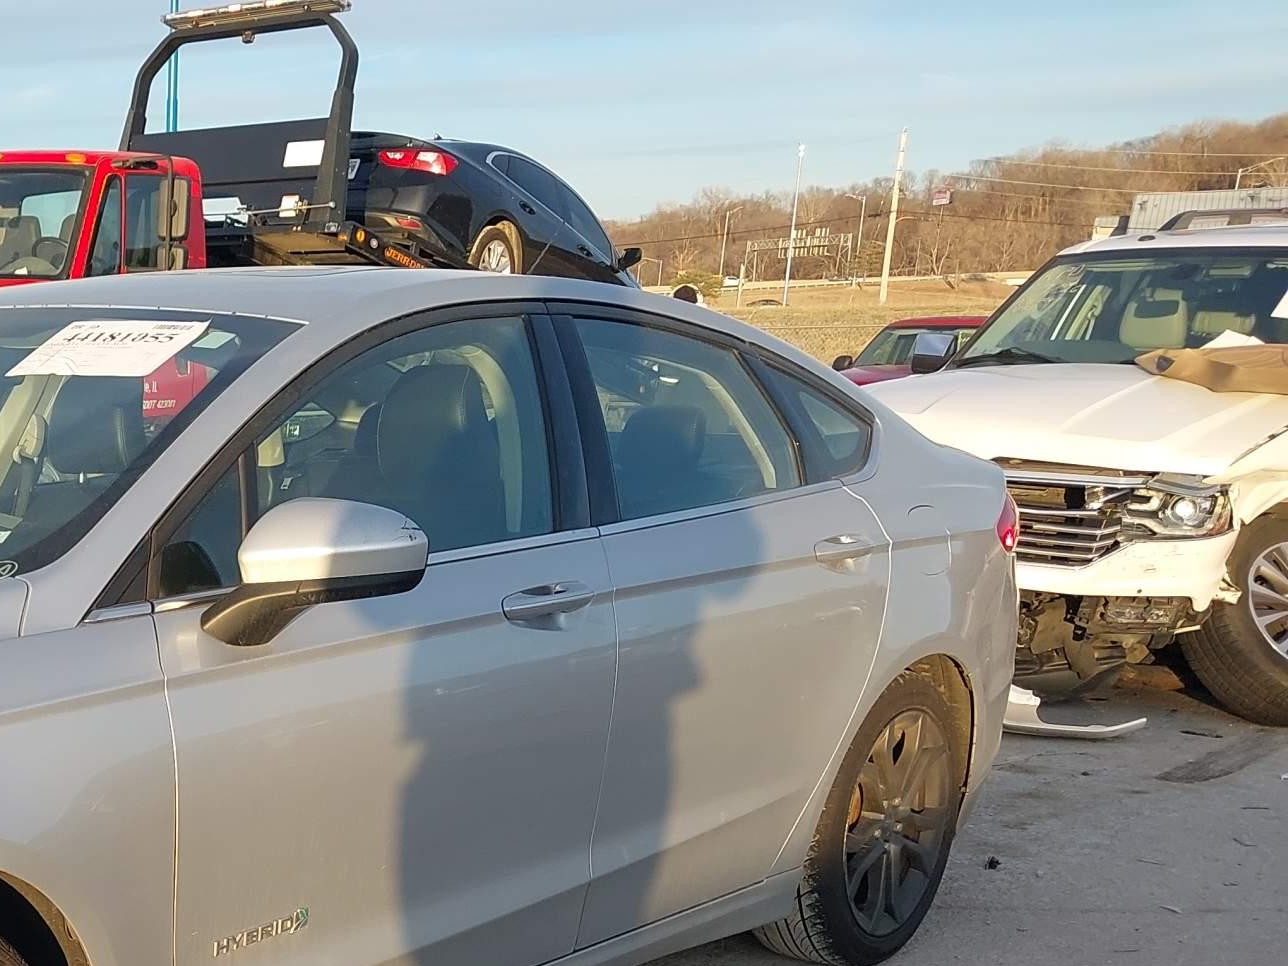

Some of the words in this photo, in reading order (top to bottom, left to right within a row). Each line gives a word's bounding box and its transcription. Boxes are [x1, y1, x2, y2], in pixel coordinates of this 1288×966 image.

[385, 247, 425, 269] JERR-DA
[63, 331, 179, 343] 44181055
[212, 917, 294, 957] HYBRID
